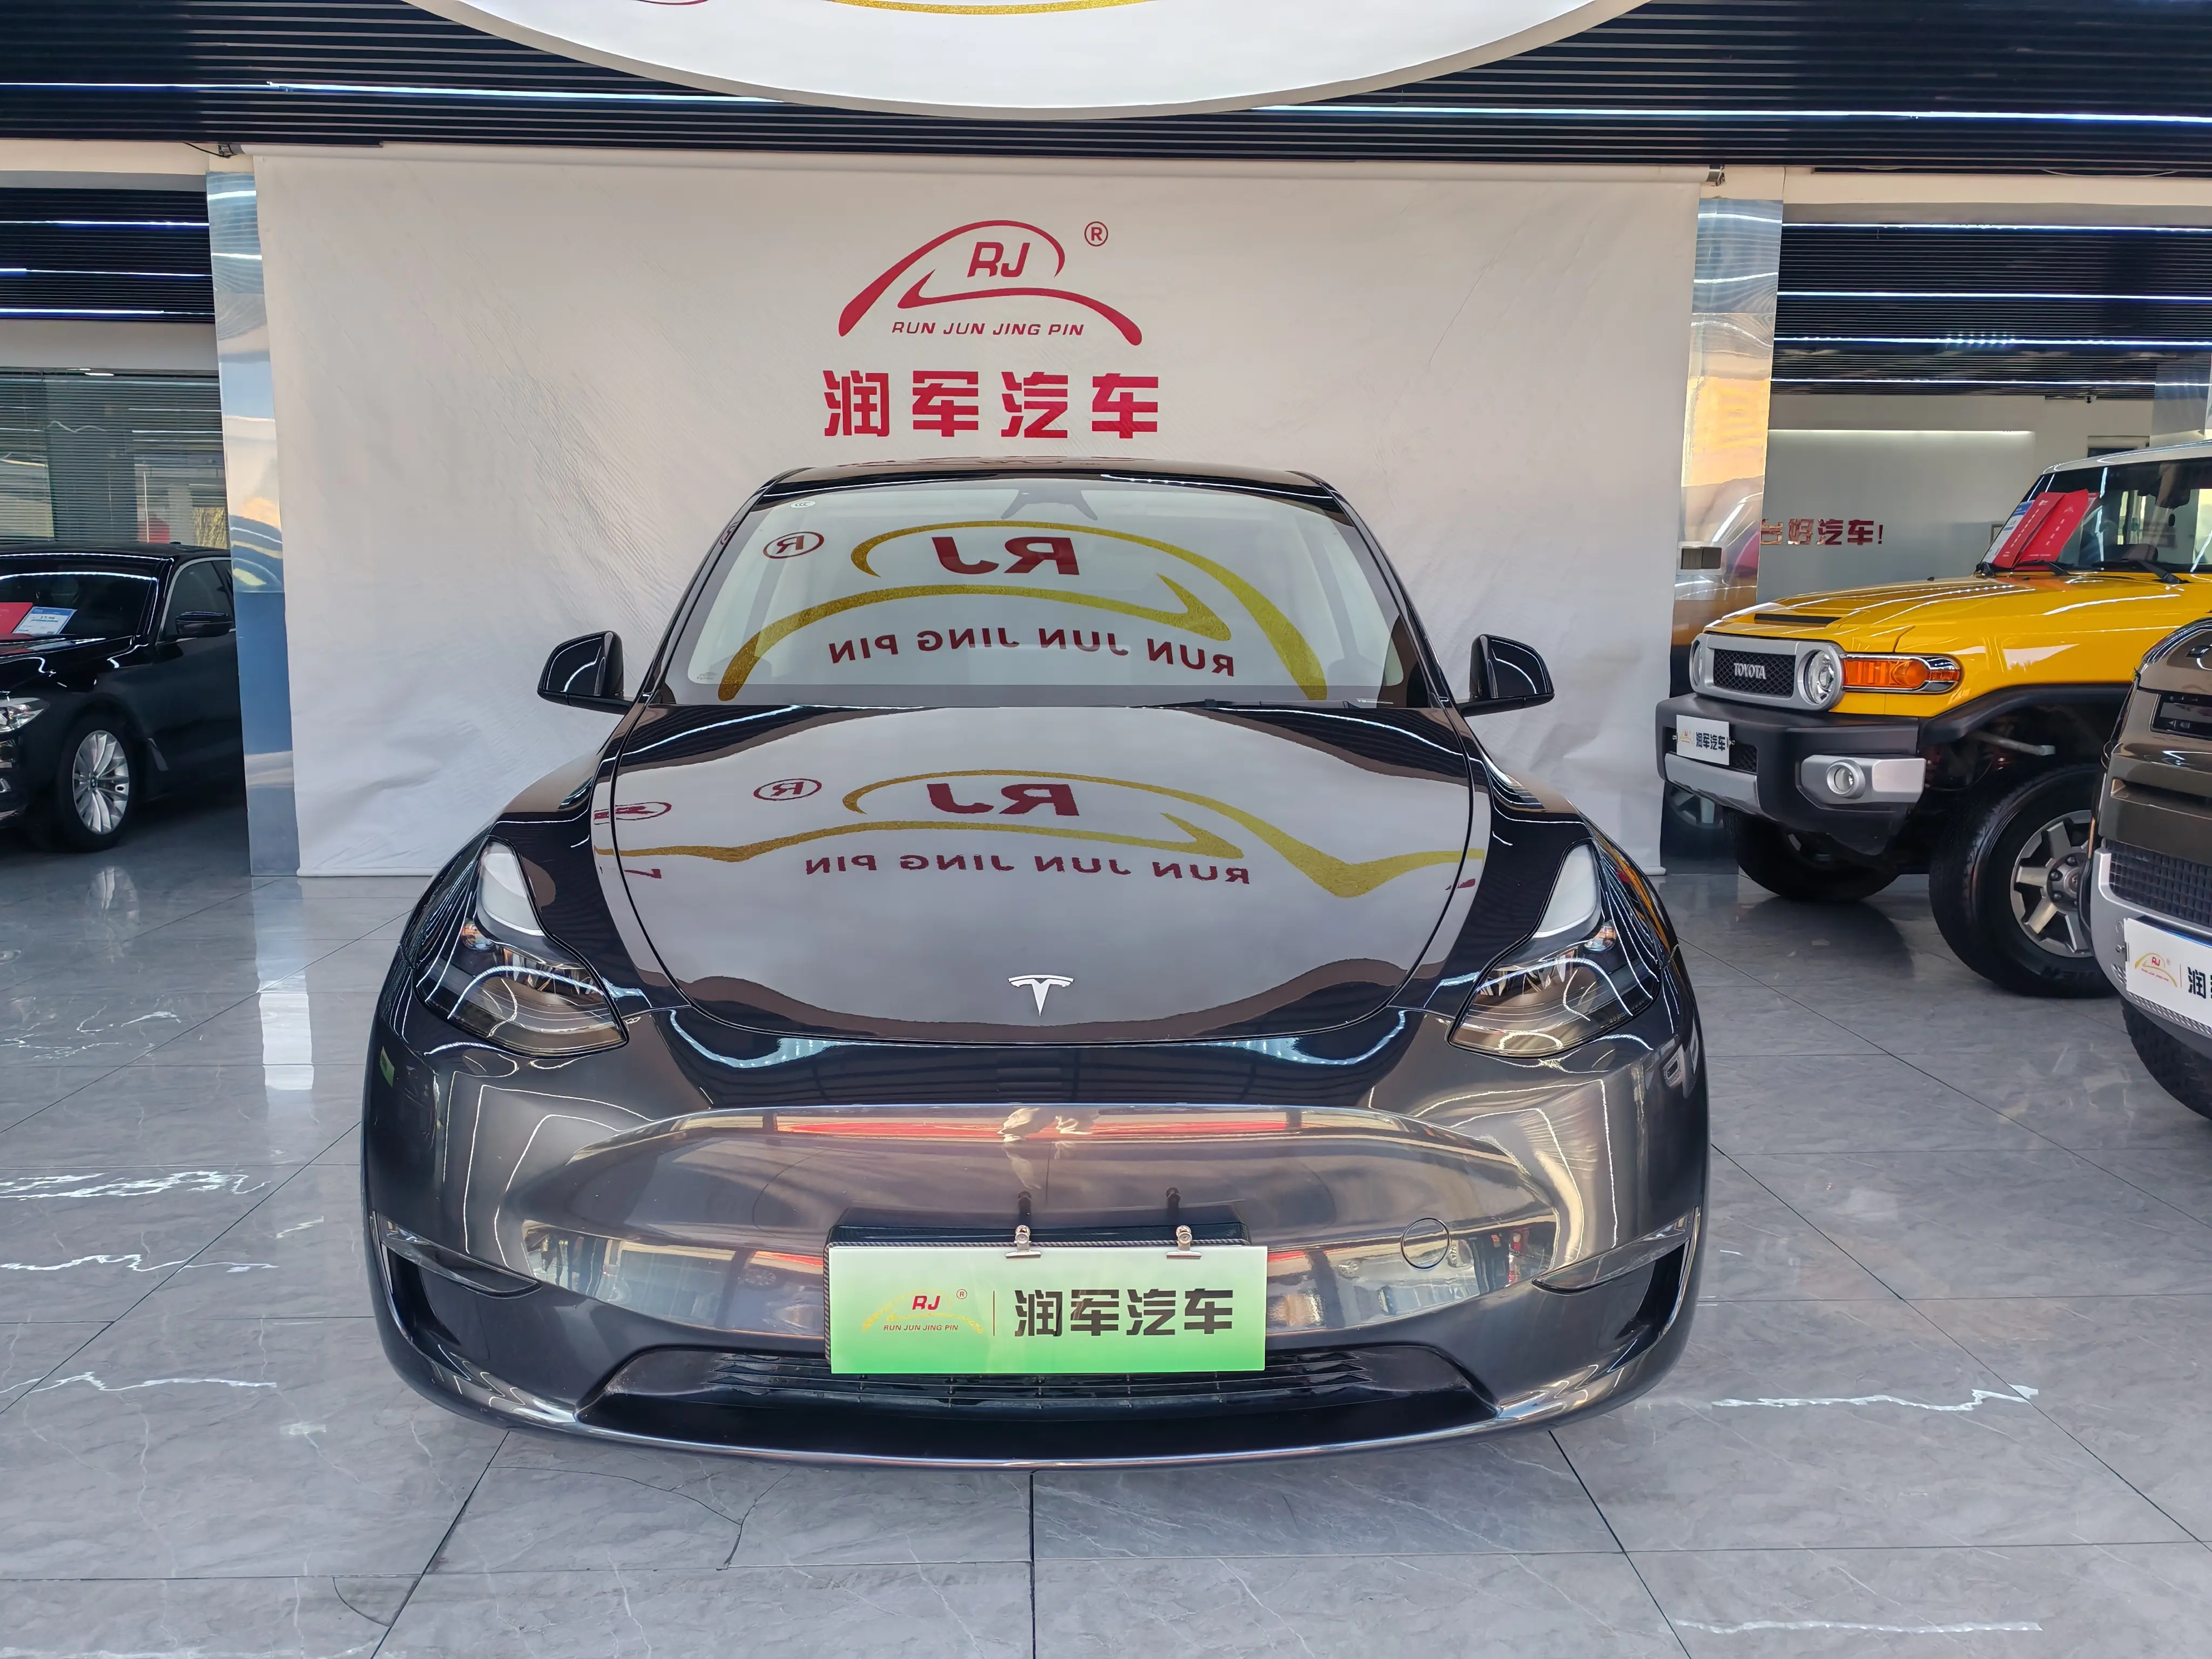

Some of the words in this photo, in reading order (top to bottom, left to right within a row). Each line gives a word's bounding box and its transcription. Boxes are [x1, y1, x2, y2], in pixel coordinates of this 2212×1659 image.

[966, 241, 1030, 279] RJ
[892, 321, 936, 335] RUN
[942, 322, 986, 336] JUN
[992, 323, 1041, 336] JING
[1048, 324, 1084, 336] PIN
[822, 369, 1159, 440] 润军汽车
[1734, 663, 1766, 679] TOYOTA
[1696, 732, 1725, 751] 润军汽车
[2152, 956, 2160, 966] RJ
[912, 1296, 941, 1310] RJ
[1015, 1289, 1233, 1337] 润军汽车
